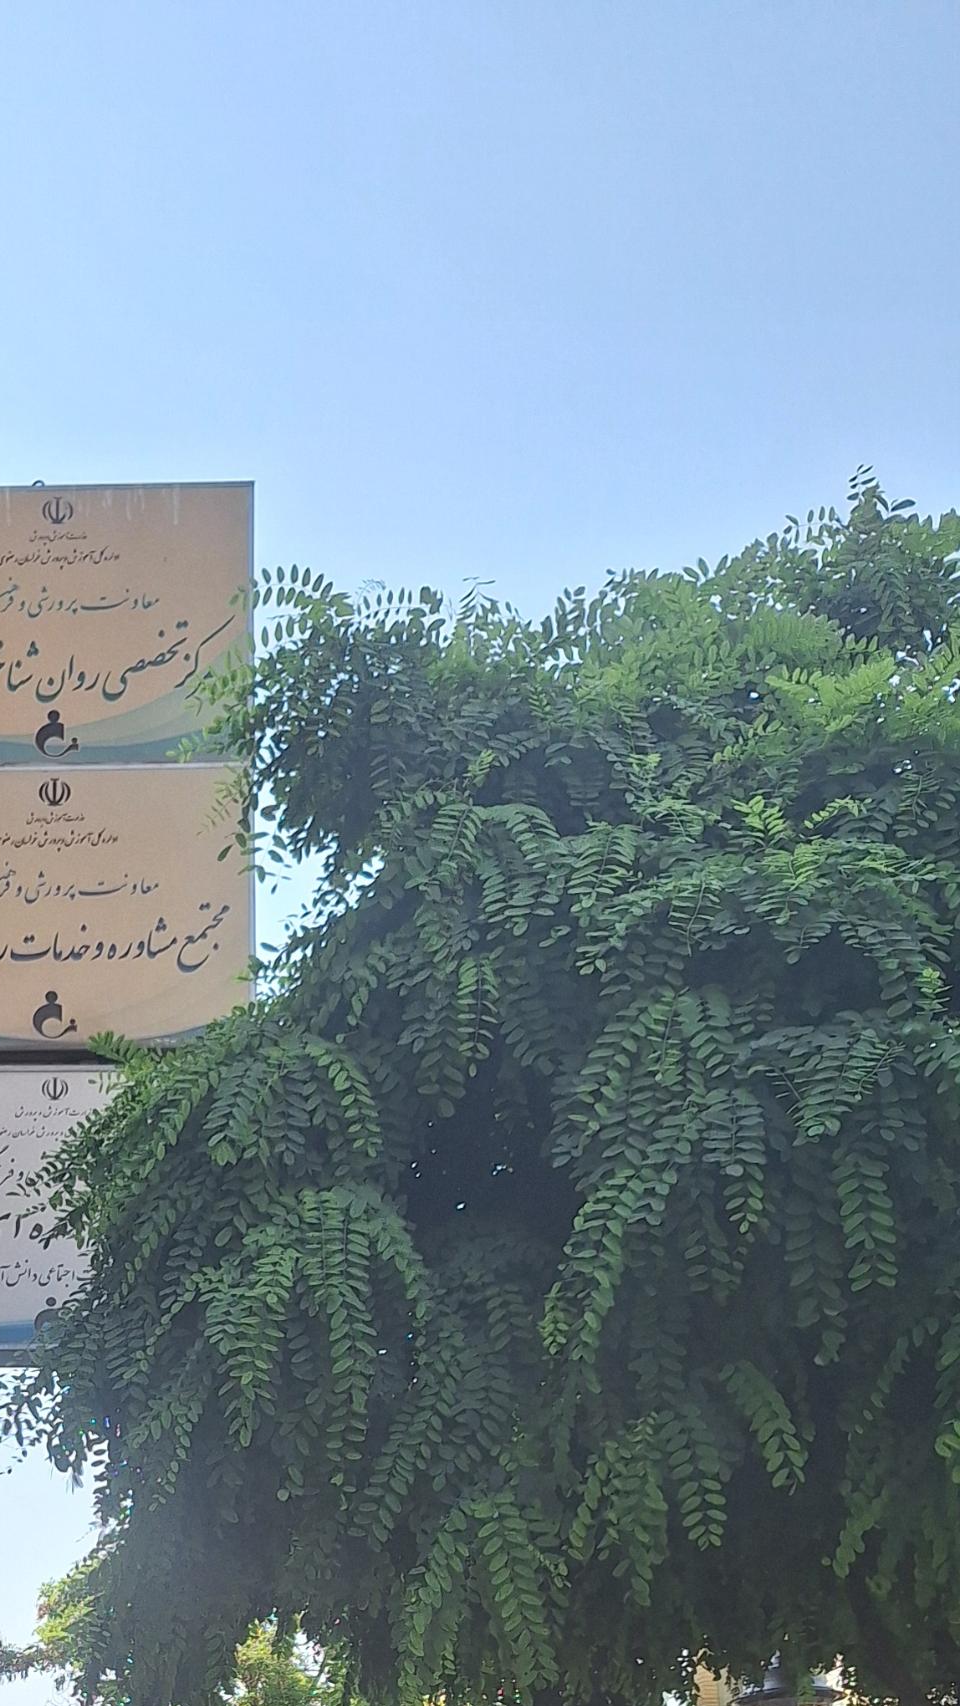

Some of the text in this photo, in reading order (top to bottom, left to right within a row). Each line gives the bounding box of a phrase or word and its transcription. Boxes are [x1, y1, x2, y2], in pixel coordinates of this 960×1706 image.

[17, 600, 26, 612] و
[27, 585, 78, 618] پرورشی
[80, 588, 160, 612] معاونت
[102, 620, 189, 701] تخصصی
[35, 654, 100, 703] روان
[64, 830, 93, 847] آموزش
[15, 886, 23, 898] و
[25, 870, 76, 904] پرورشی
[78, 872, 159, 897] معاونت
[10, 923, 91, 962] خدمات
[107, 917, 177, 960] مشاوره
[177, 902, 230, 973] مجتمع
[90, 941, 105, 961] و
[12, 1126, 35, 1139] خراسان
[36, 1125, 60, 1141] پرورش
[38, 1263, 76, 1288] اجتماعی
